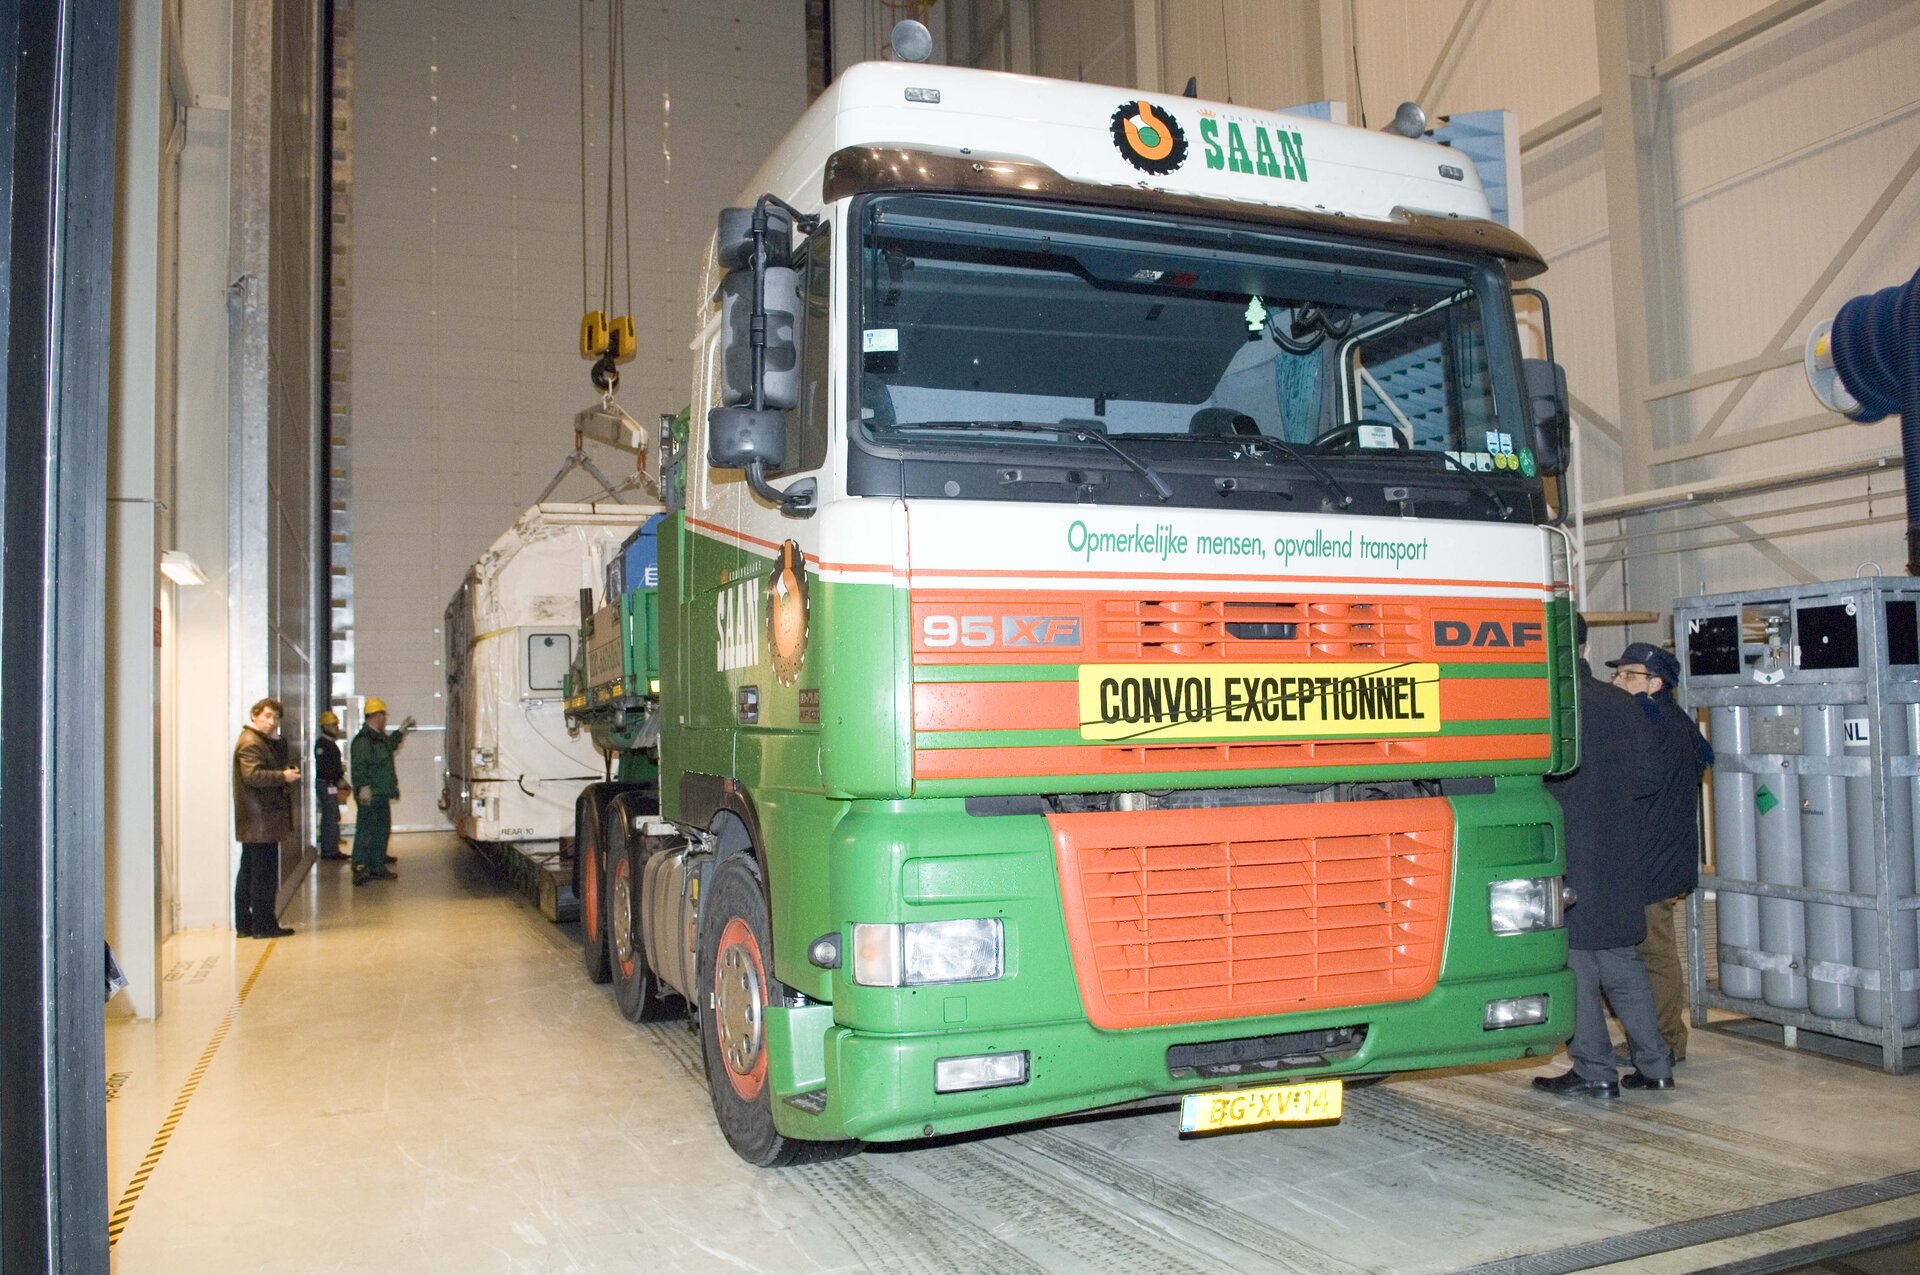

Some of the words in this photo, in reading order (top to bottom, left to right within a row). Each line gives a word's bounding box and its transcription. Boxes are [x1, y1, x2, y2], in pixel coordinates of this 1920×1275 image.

[1200, 117, 1308, 182] SAAN
[1067, 520, 1188, 562] Opmerkelijke
[1196, 534, 1266, 559] mensen,
[1274, 529, 1352, 566] opvallend
[1359, 534, 1428, 569] transport
[716, 577, 759, 673] SAAN
[923, 615, 996, 647] 95
[1007, 620, 1077, 643] XF
[1434, 620, 1542, 648] DAF
[1100, 677, 1213, 724] CONVOI
[1225, 677, 1425, 722] EXCEPTIONNEL
[1844, 722, 1868, 741] NL
